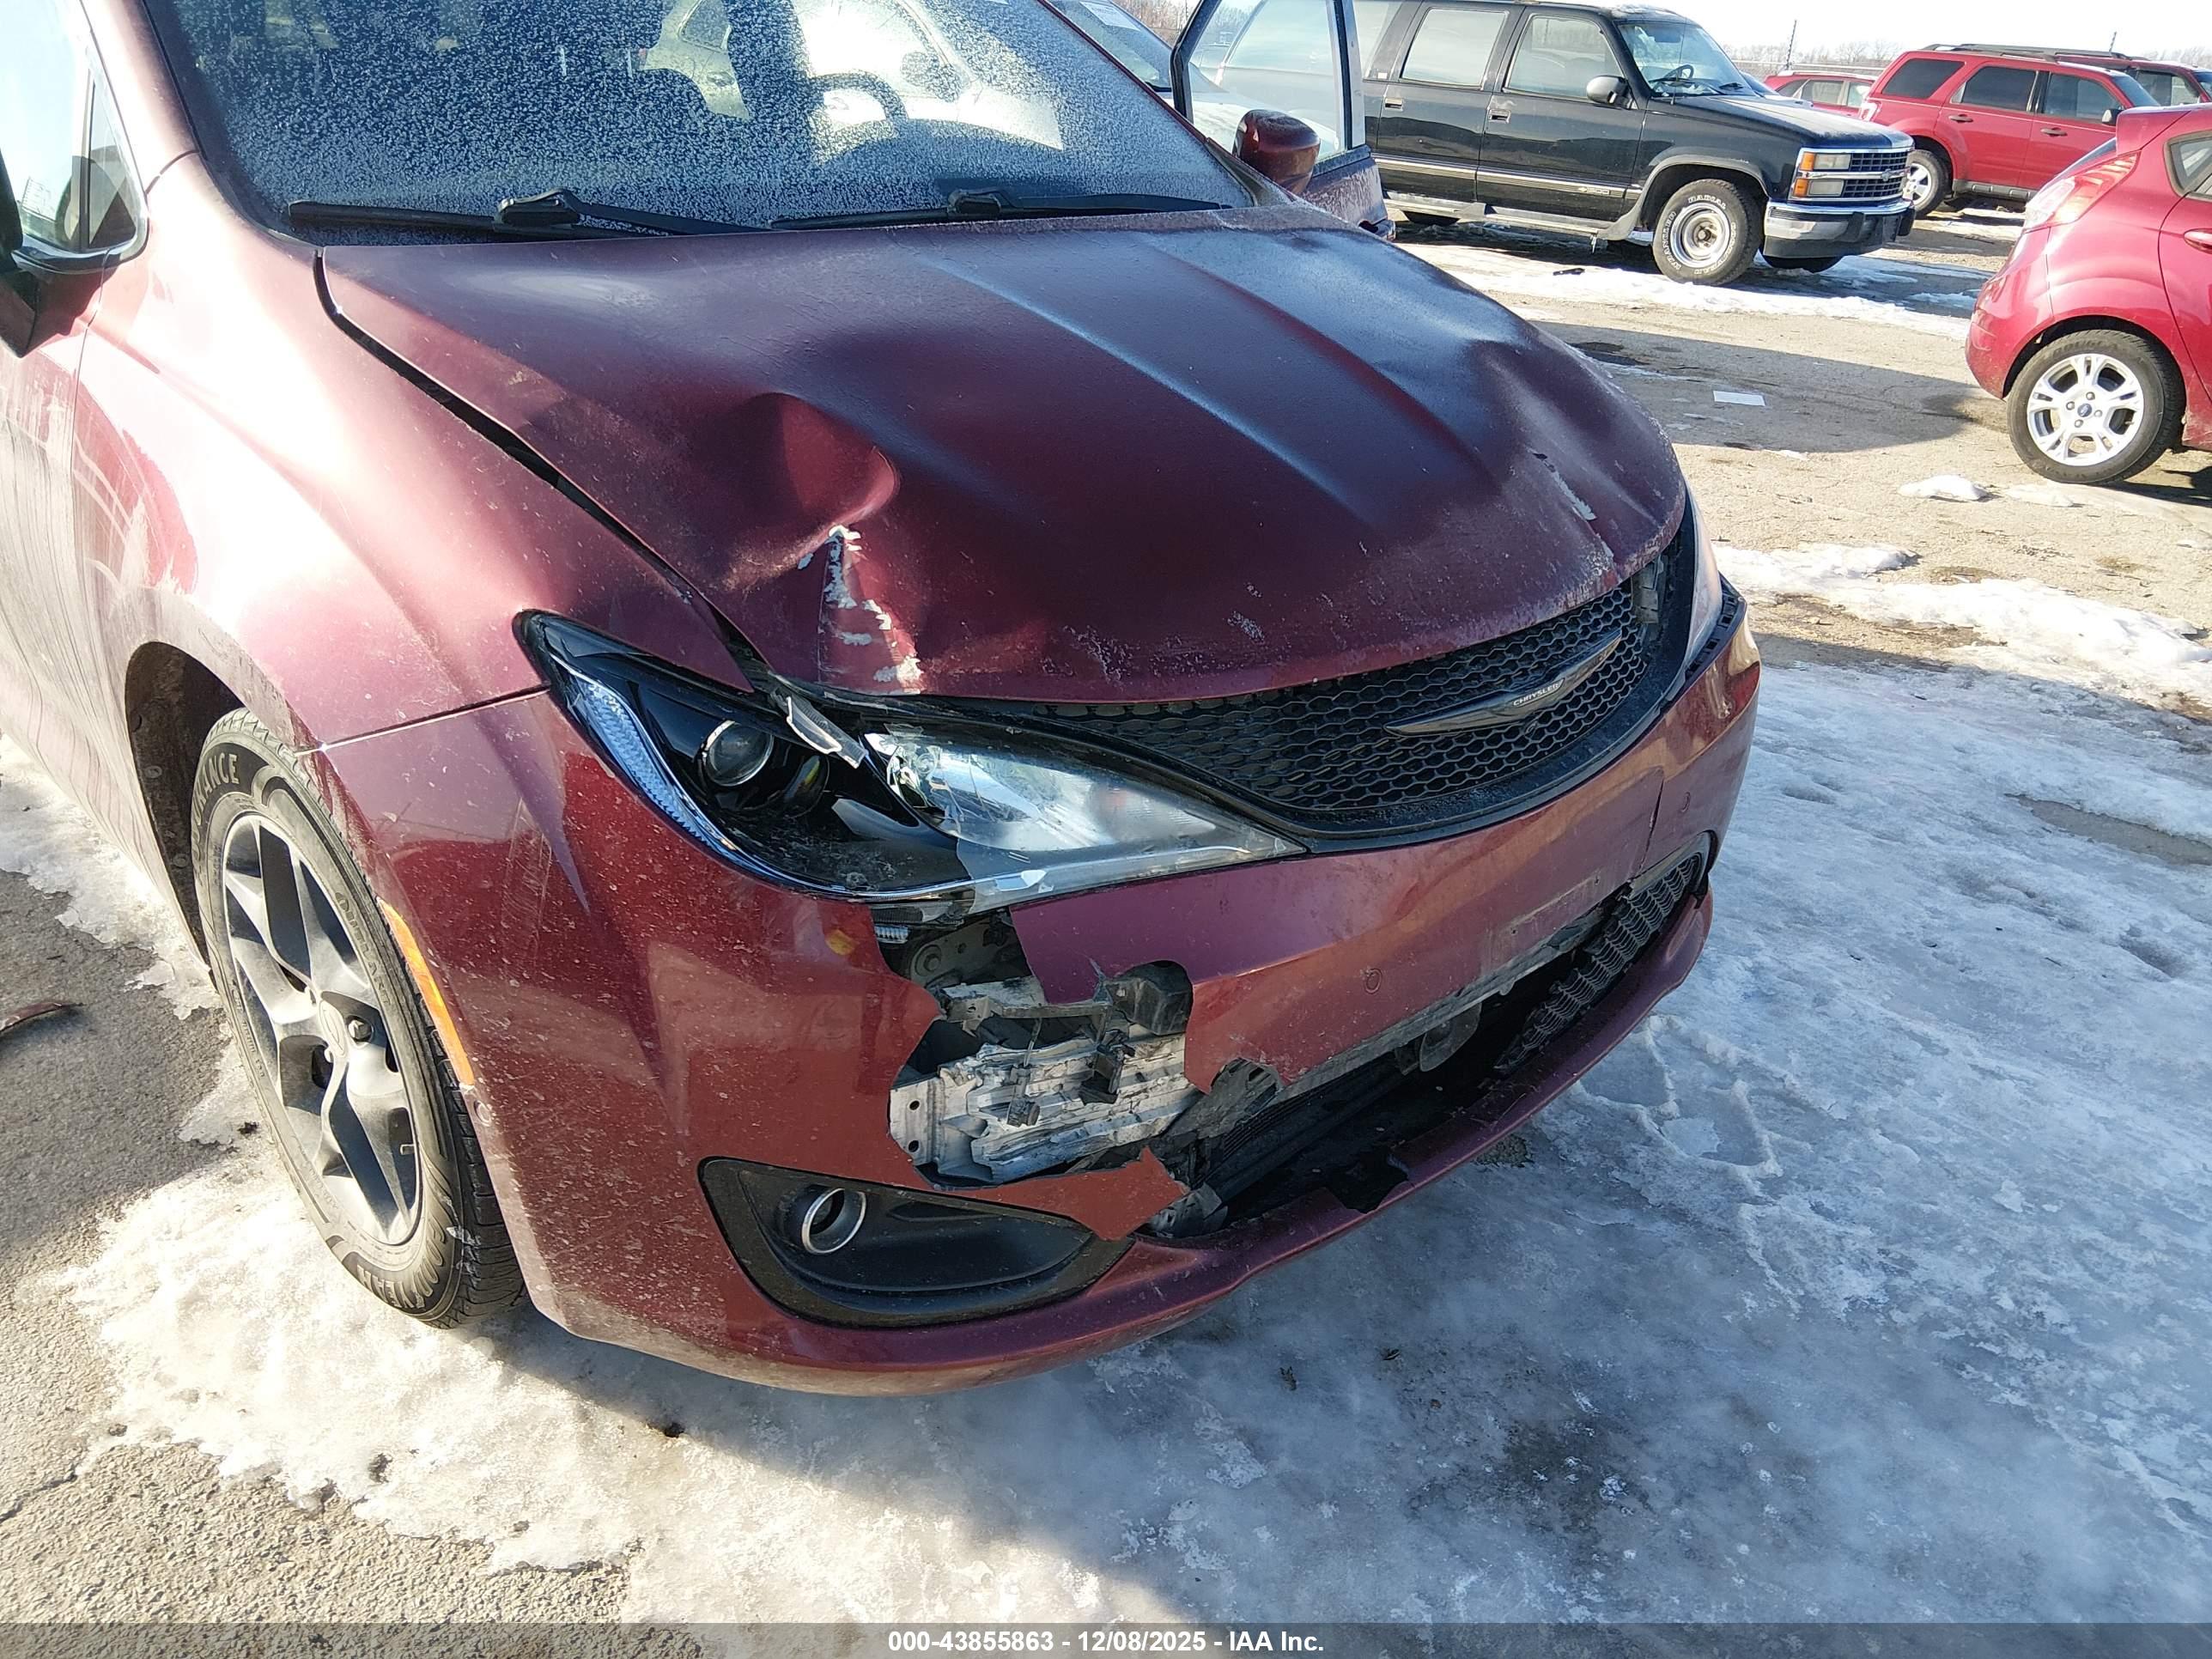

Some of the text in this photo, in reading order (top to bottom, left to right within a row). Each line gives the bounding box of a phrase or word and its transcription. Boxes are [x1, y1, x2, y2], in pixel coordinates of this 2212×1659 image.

[1688, 194, 1726, 210] RADIAL
[1662, 210, 1682, 270] WRANGLER
[1513, 683, 1559, 706] CHRYSLER
[356, 1212, 446, 1310] GOODYEAR
